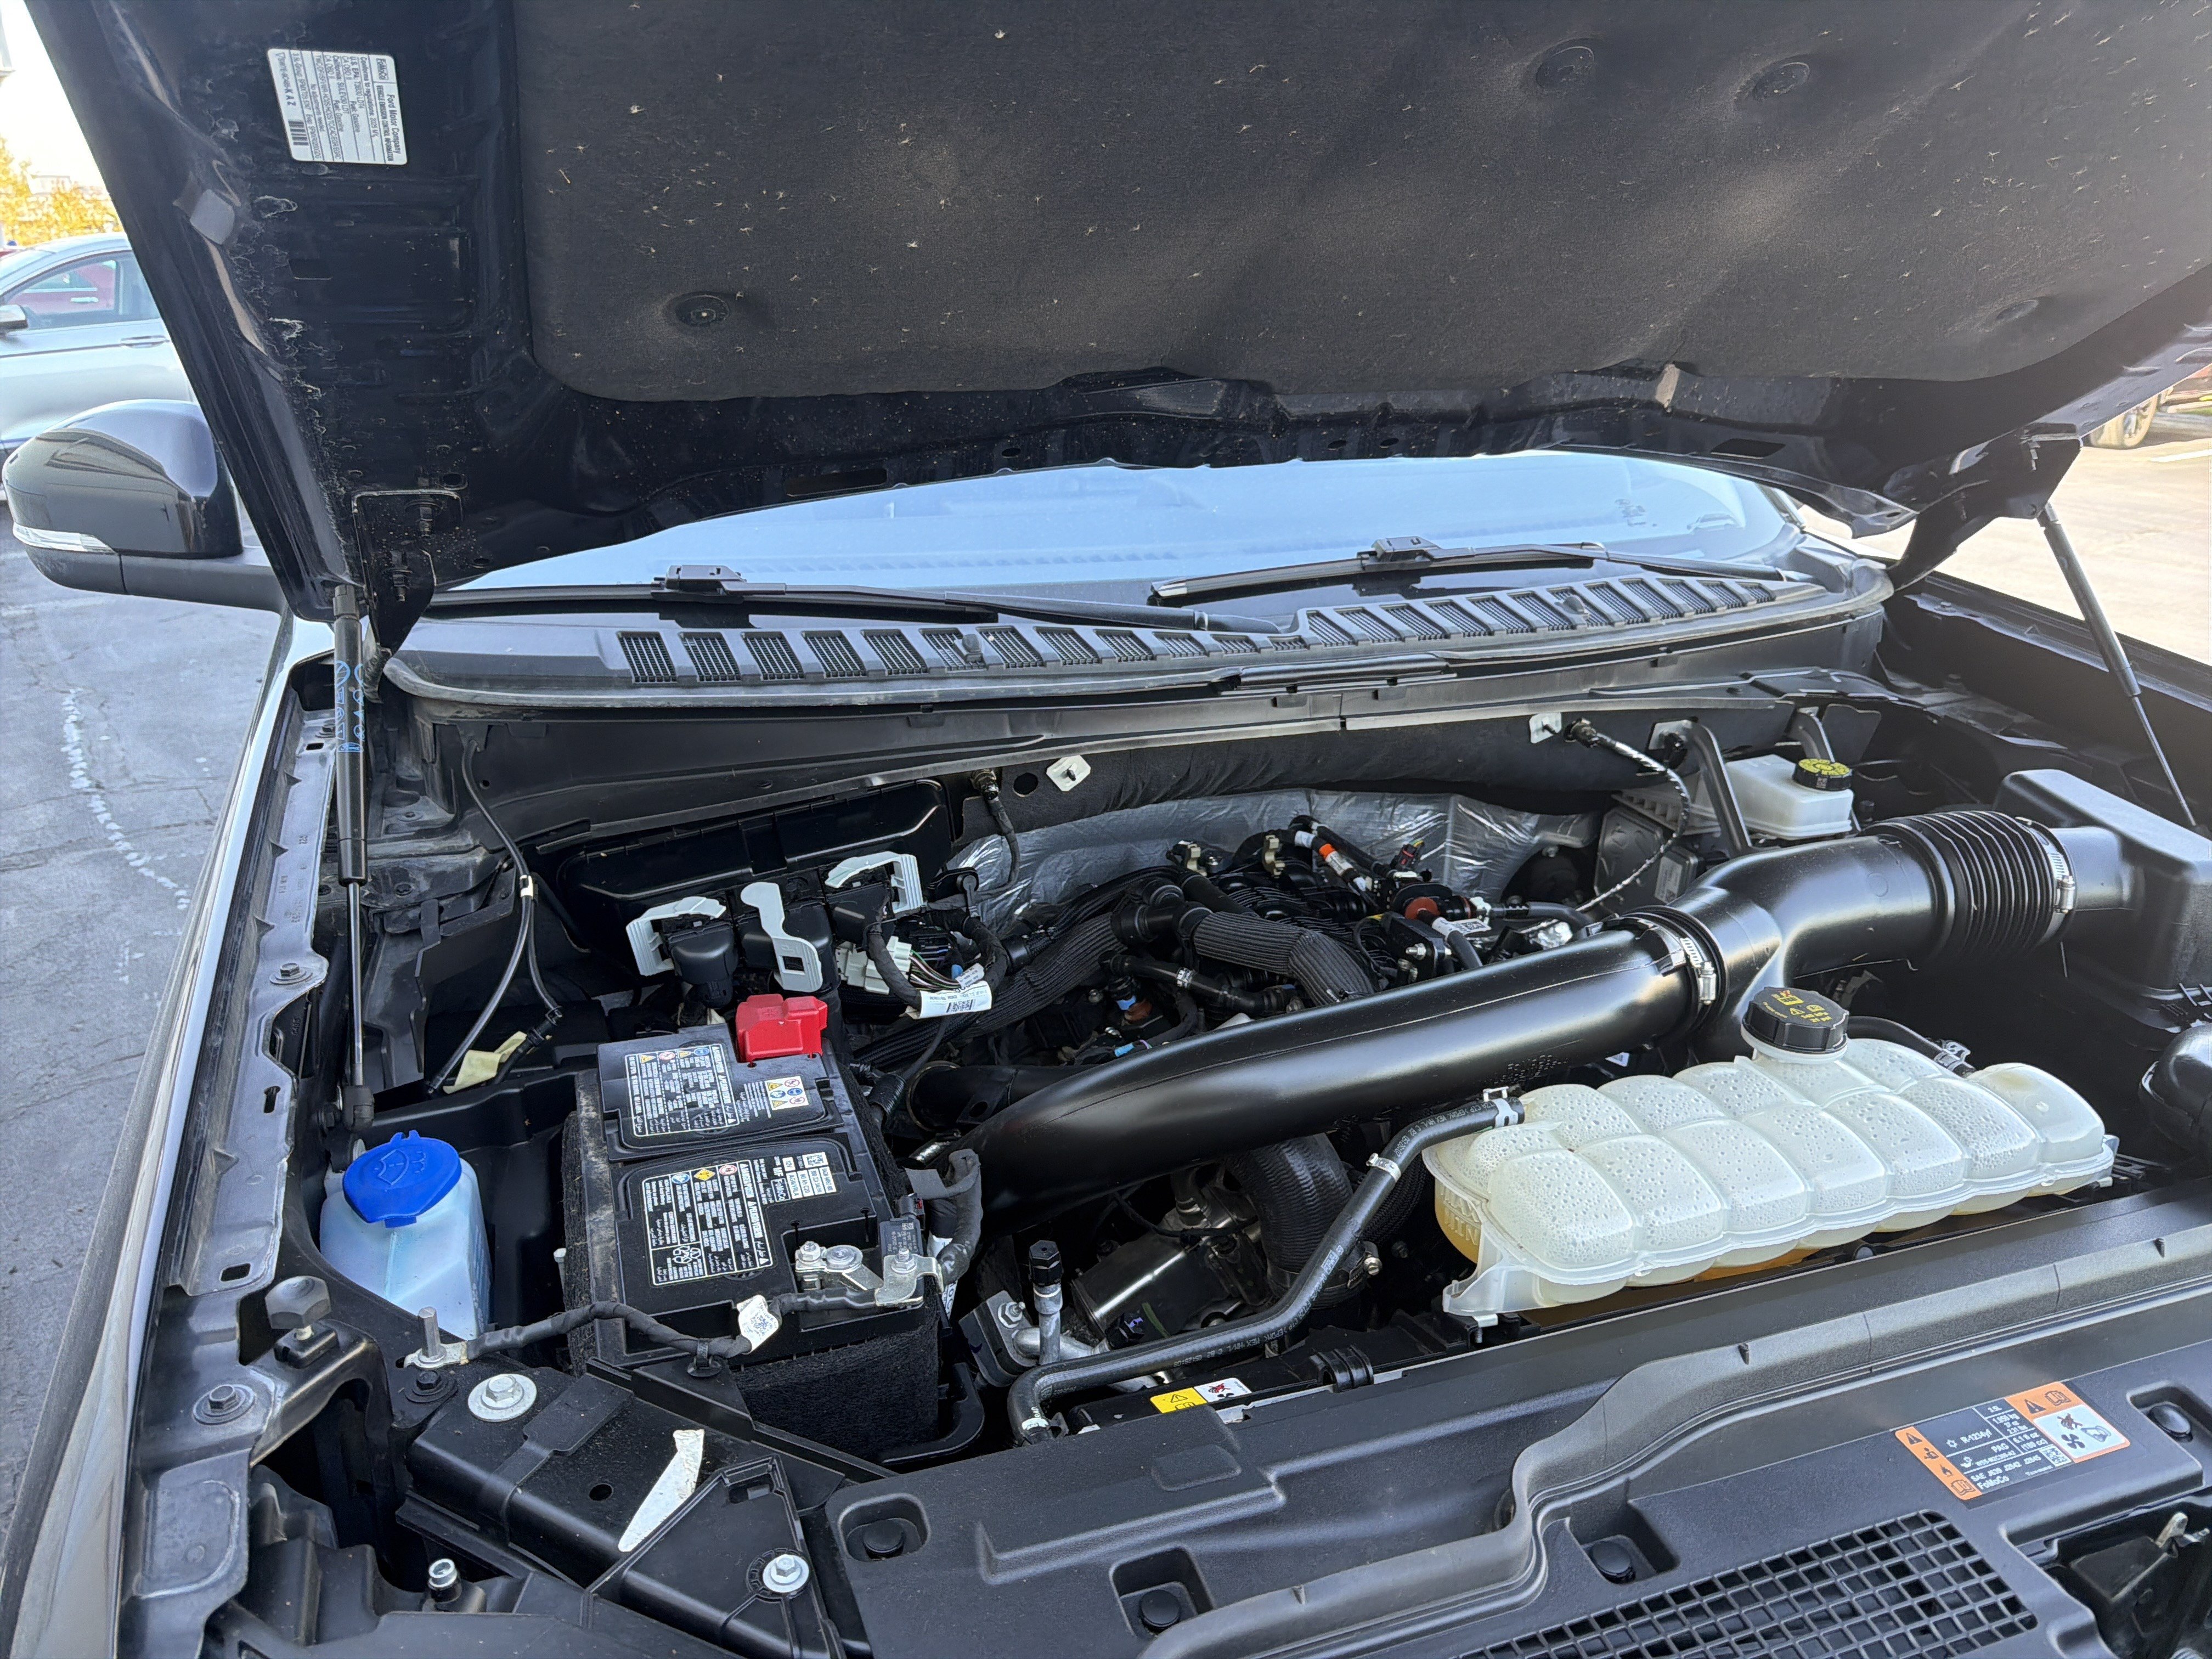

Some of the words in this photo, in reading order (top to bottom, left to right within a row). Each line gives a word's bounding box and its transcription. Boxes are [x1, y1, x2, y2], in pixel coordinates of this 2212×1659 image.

[360, 57, 369, 81] Conforms
[376, 85, 385, 100] VEHICLE
[311, 91, 321, 115] adjustments
[364, 88, 374, 116] regulations:
[335, 113, 343, 131] Gasoline
[387, 94, 396, 108] Ford
[392, 128, 400, 154] Company
[775, 1180, 786, 1201] FoMoCo
[1960, 1429, 1991, 1443] R-1234yf
[1991, 1443, 2009, 1452] PAG
[1971, 1473, 1986, 1481] SAE
[1977, 1476, 2009, 1489] FoMoCo
